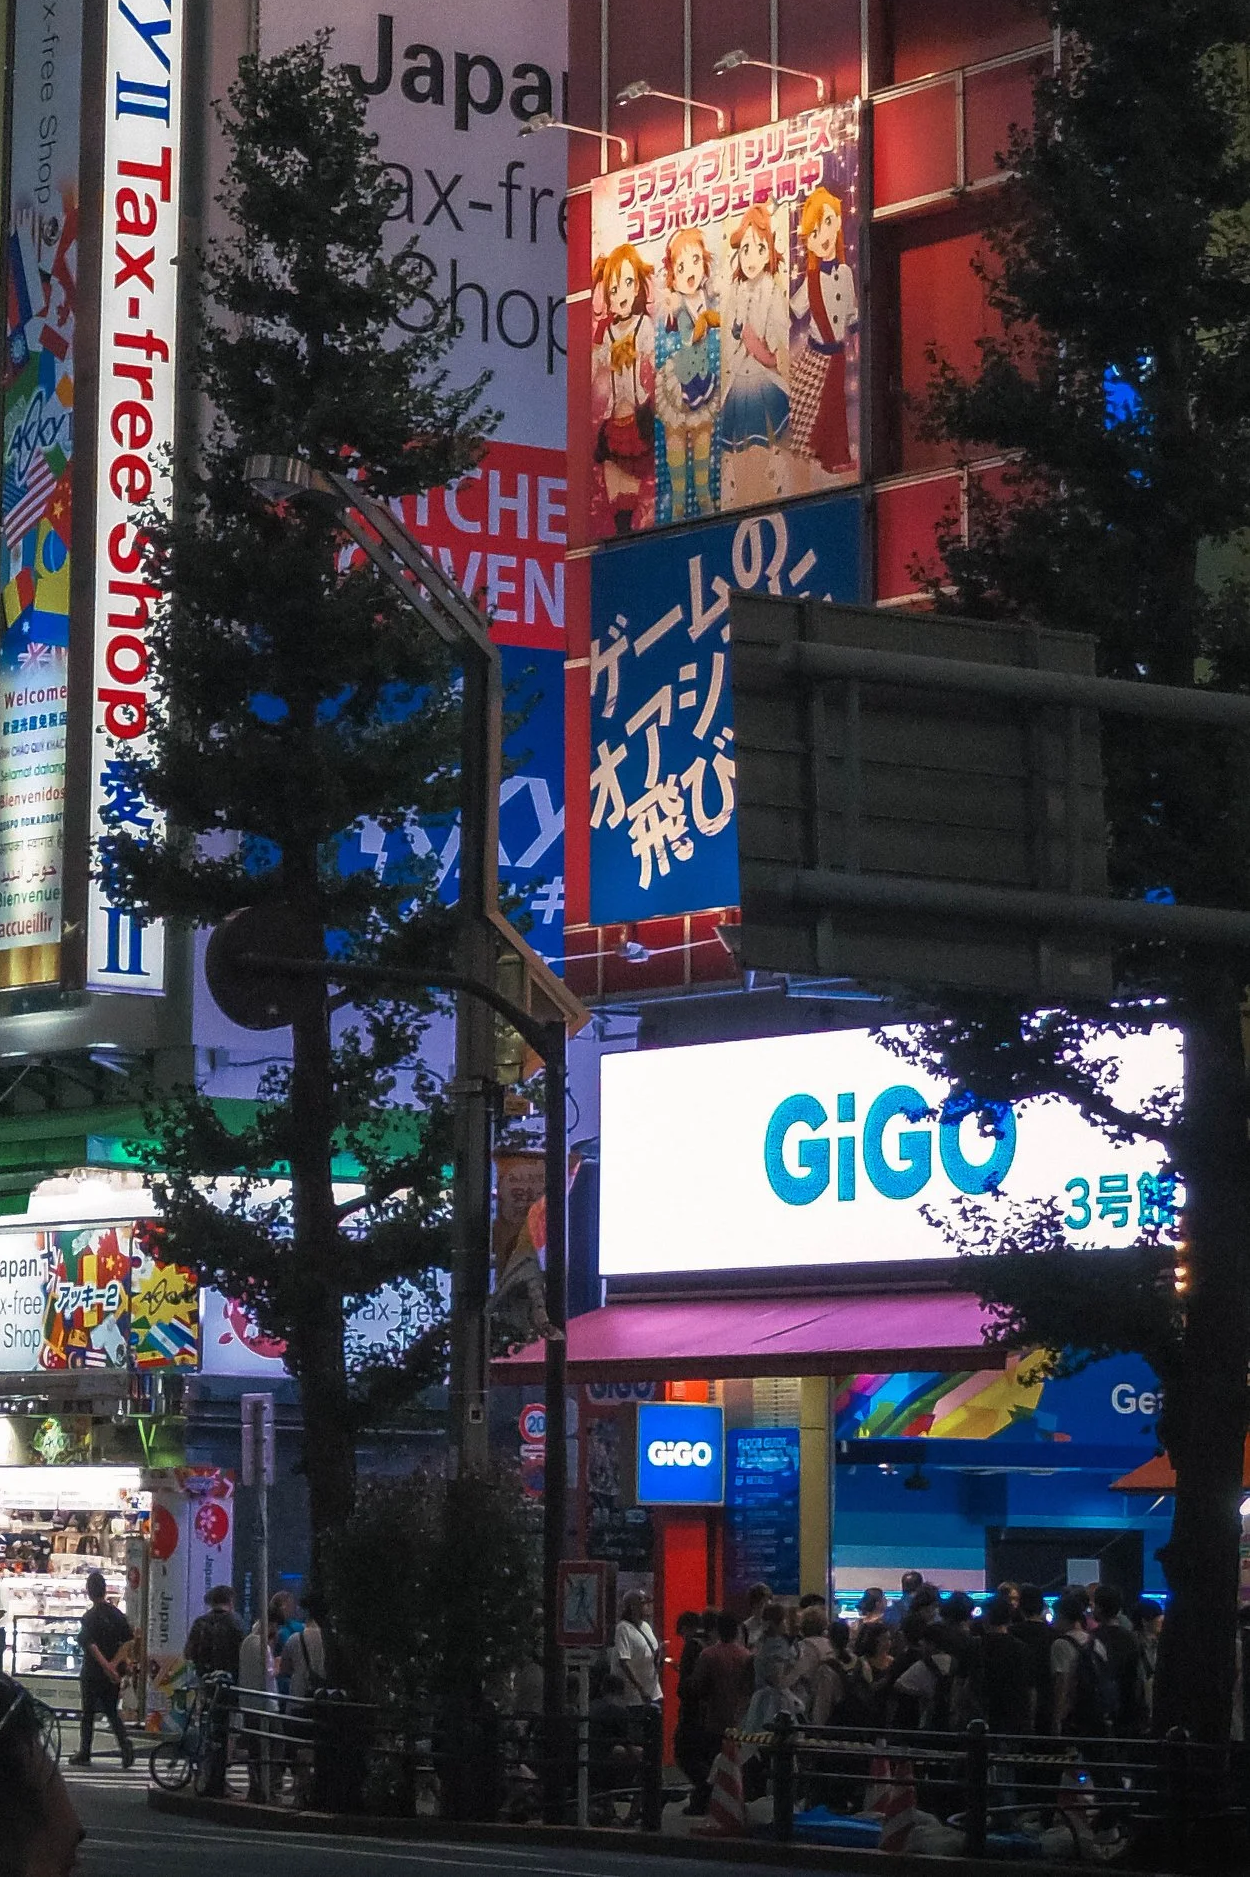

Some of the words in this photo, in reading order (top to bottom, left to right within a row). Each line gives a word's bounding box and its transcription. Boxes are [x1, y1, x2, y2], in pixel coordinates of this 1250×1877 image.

[350, 14, 568, 131] Japa
[33, 114, 57, 204] Shop
[108, 146, 172, 504] Tax-free
[4, 685, 67, 709] Welcome
[590, 652, 725, 829] オアシ
[0, 787, 65, 809] Bienvenidos
[764, 1085, 1017, 1206] GiGO
[57, 1282, 119, 1309] アッキー2
[3, 1323, 41, 1353] Shop
[528, 1413, 547, 1434] 20
[646, 1440, 713, 1467] GiGO
